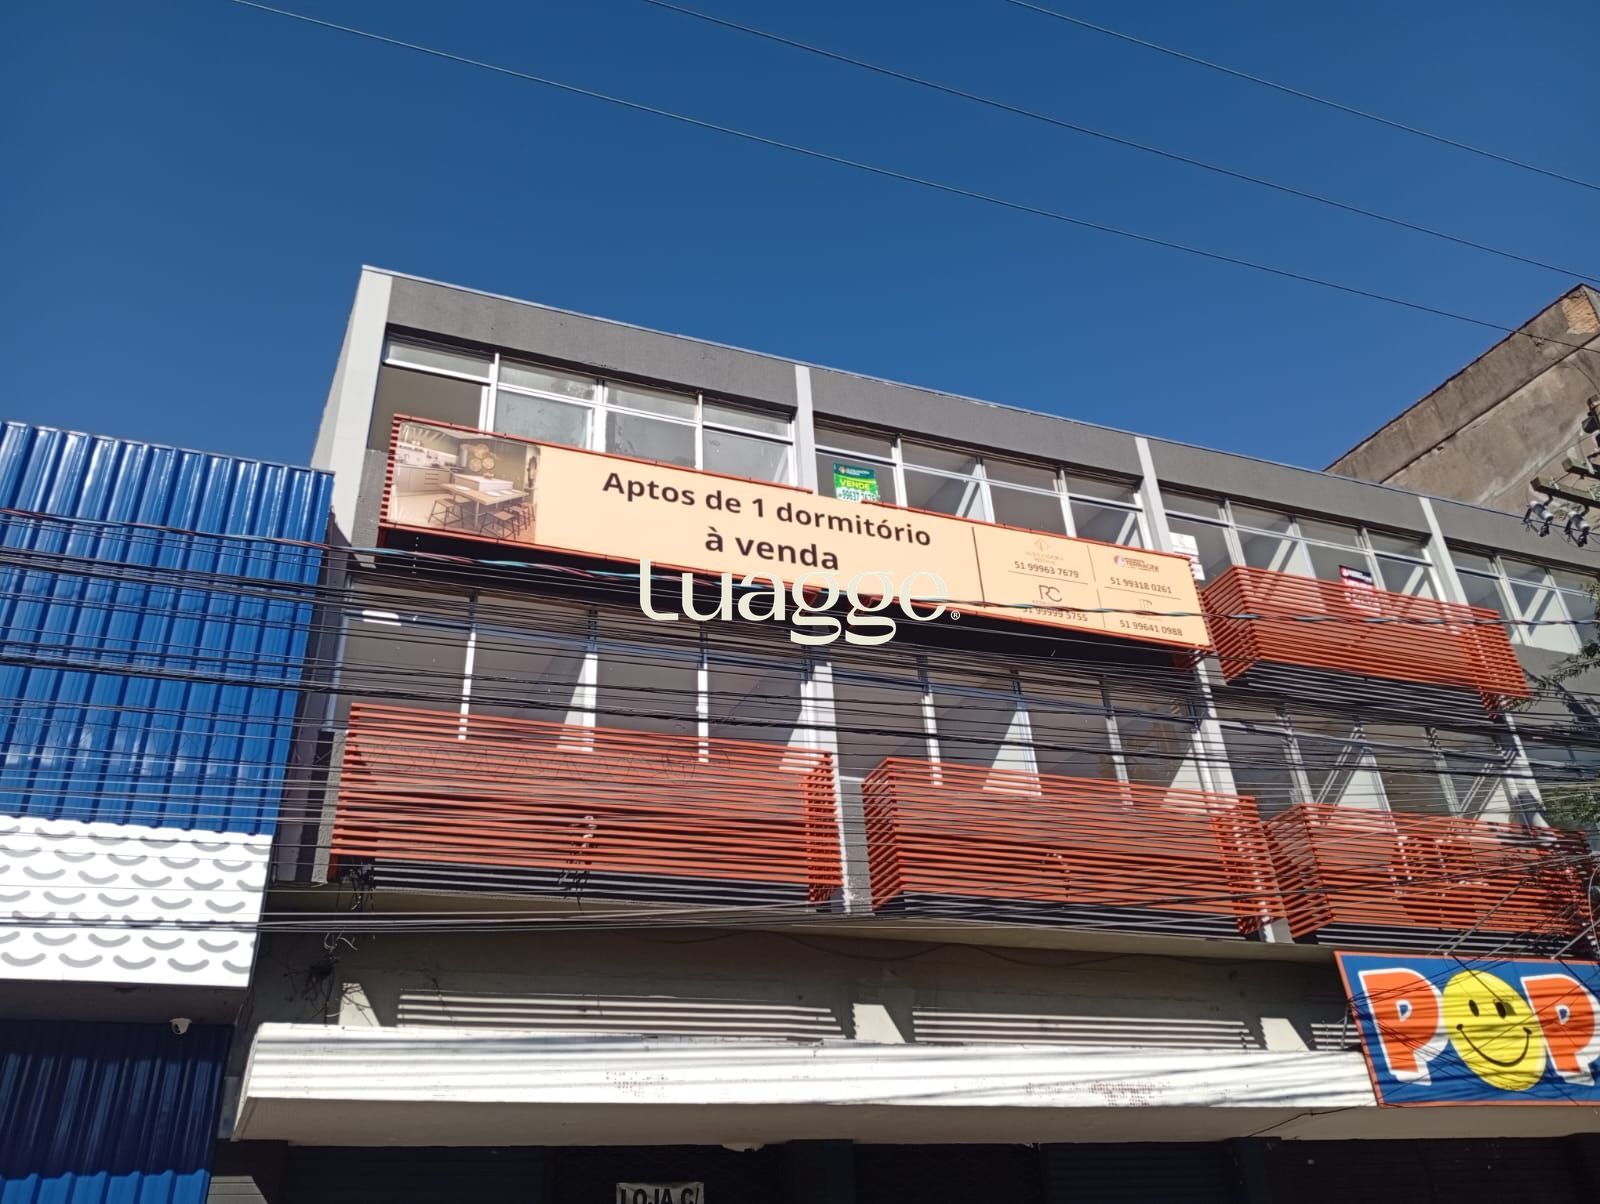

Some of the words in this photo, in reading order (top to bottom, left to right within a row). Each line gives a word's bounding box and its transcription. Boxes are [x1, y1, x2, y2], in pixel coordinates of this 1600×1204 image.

[602, 472, 695, 506] Aptos
[705, 490, 741, 514] de
[752, 498, 764, 518] 1
[776, 502, 931, 546] dormitório
[705, 526, 724, 553] à
[735, 537, 839, 570] venda
[1014, 561, 1026, 570] 51
[1027, 563, 1055, 575] 99963
[1057, 568, 1079, 579] 7679
[1110, 577, 1121, 586] 51
[1123, 579, 1149, 591] 99318
[1120, 620, 1131, 629] 51
